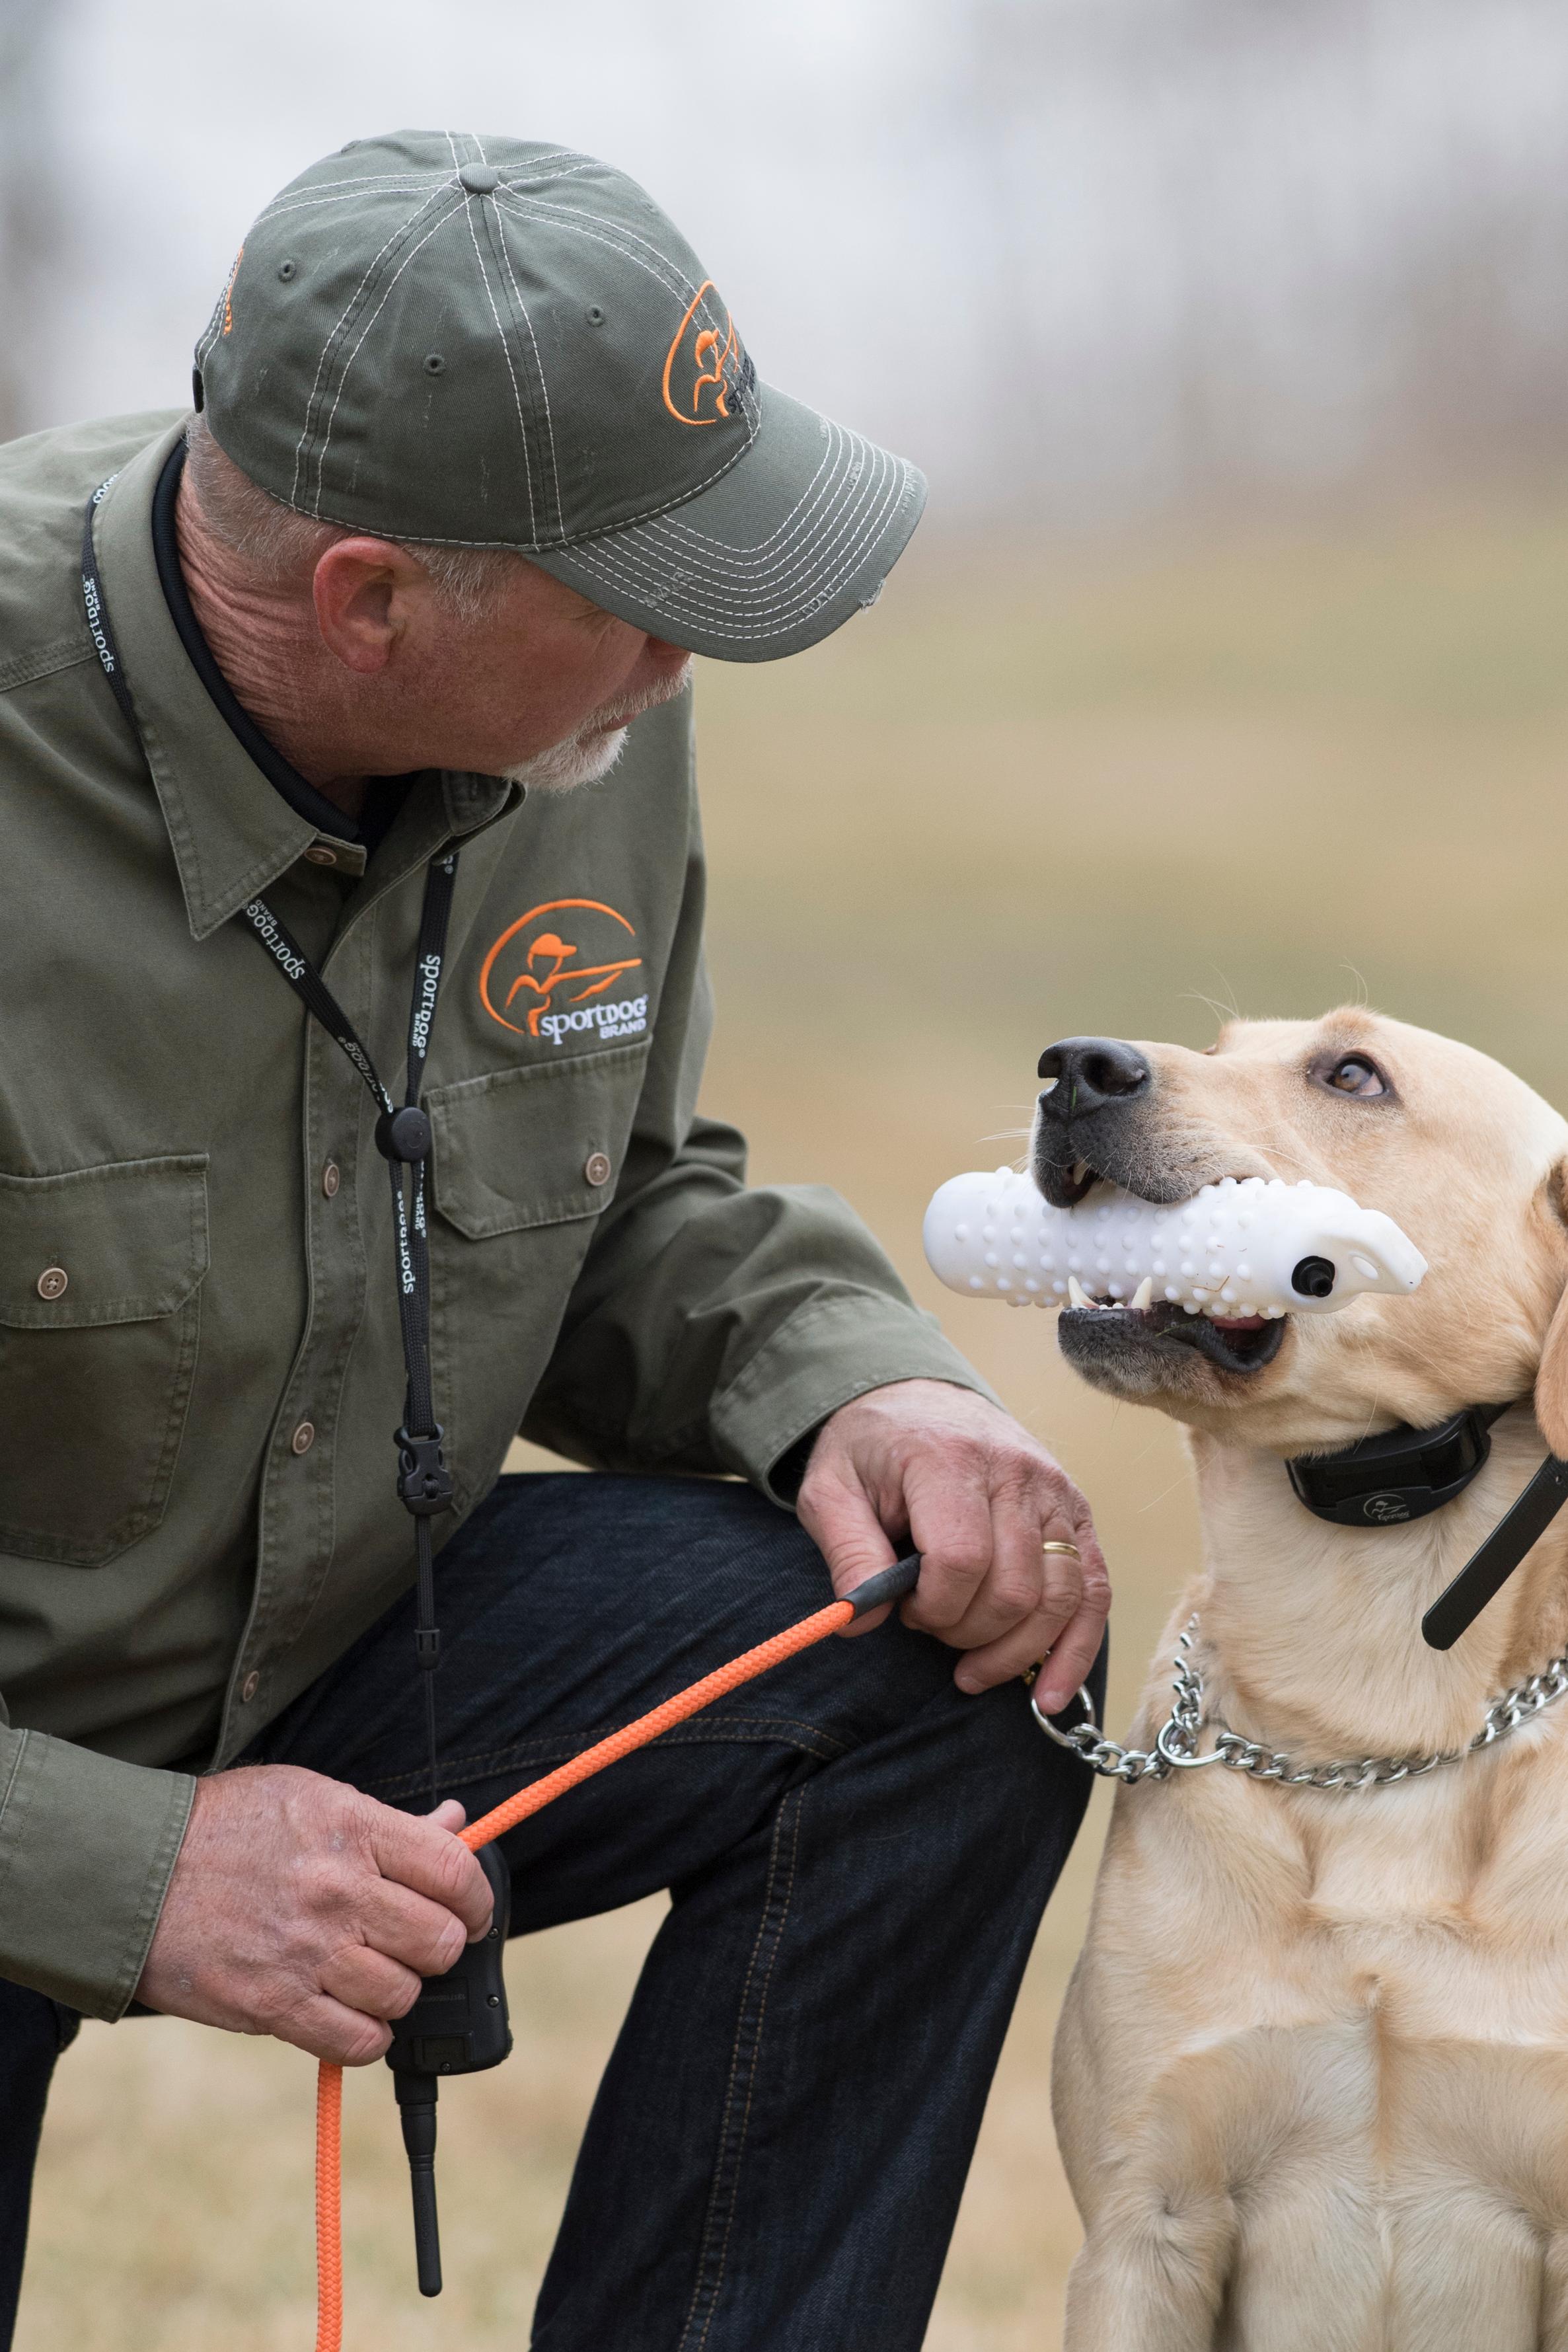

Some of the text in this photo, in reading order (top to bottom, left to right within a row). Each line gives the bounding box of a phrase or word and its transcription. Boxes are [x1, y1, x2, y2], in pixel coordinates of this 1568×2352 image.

[90, 578, 101, 611] BRAND
[255, 899, 278, 927] BRAND
[412, 1013, 421, 1047] BRAND
[599, 1018, 647, 1040] BRAND
